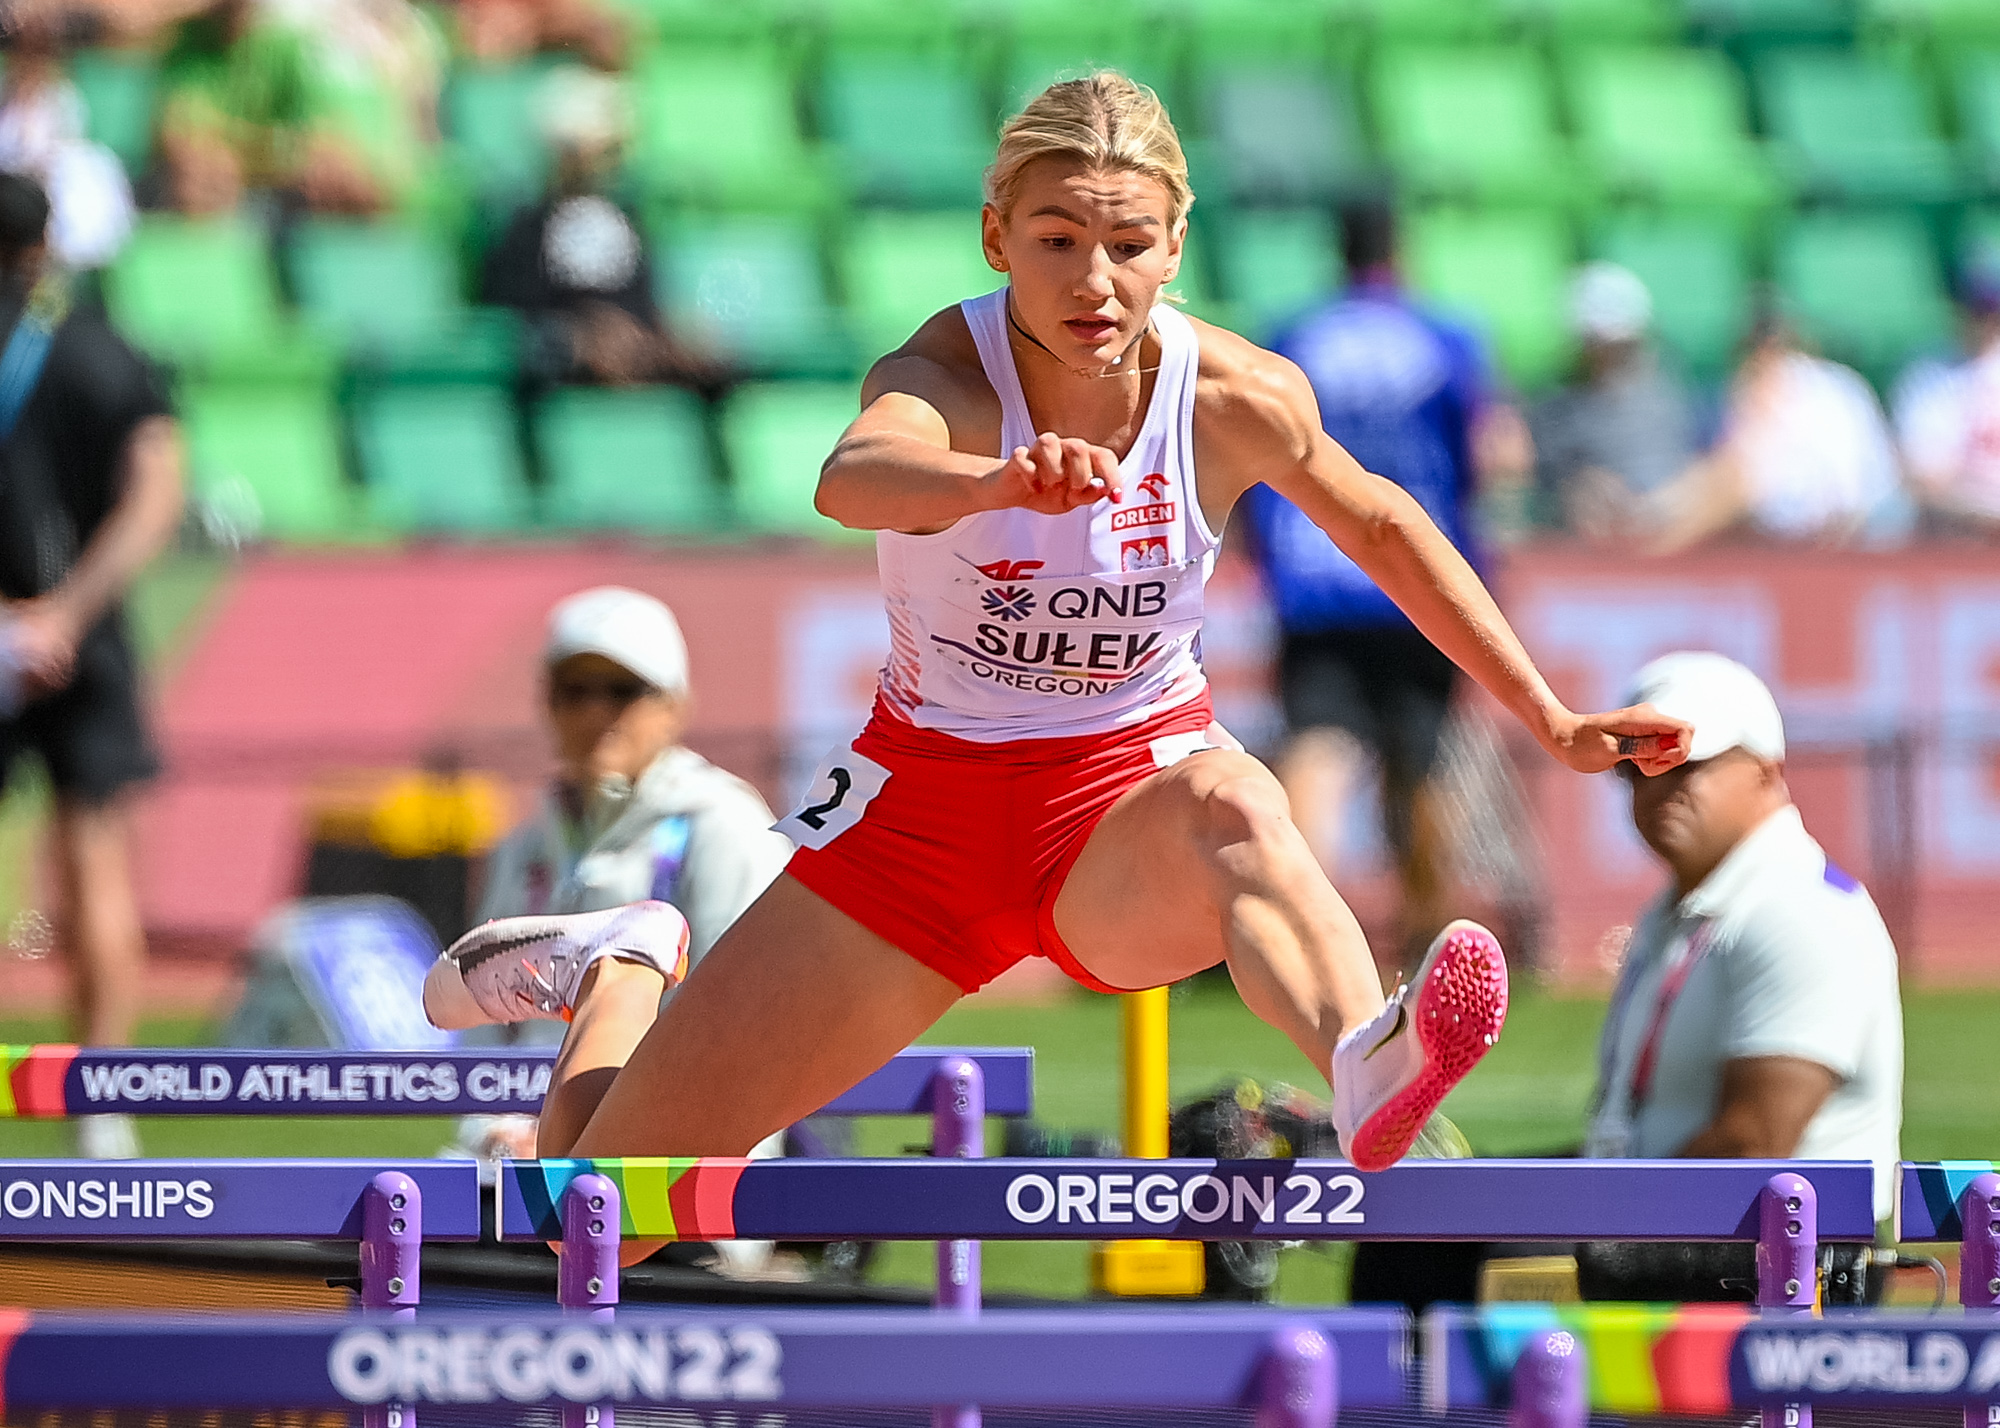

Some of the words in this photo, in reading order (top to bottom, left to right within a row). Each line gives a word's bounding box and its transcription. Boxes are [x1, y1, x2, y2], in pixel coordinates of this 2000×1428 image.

[1113, 505, 1173, 528] ORLEN
[1048, 581, 1167, 619] QNB
[796, 767, 851, 831] 2
[81, 1063, 232, 1102] WORLD
[237, 1062, 460, 1102] ATHLETICS
[0, 1180, 214, 1219] ONSHIPS
[1005, 1174, 1365, 1224] OREGON22
[329, 1325, 783, 1403] OREGON22
[1746, 1333, 1969, 1393] WORLD
